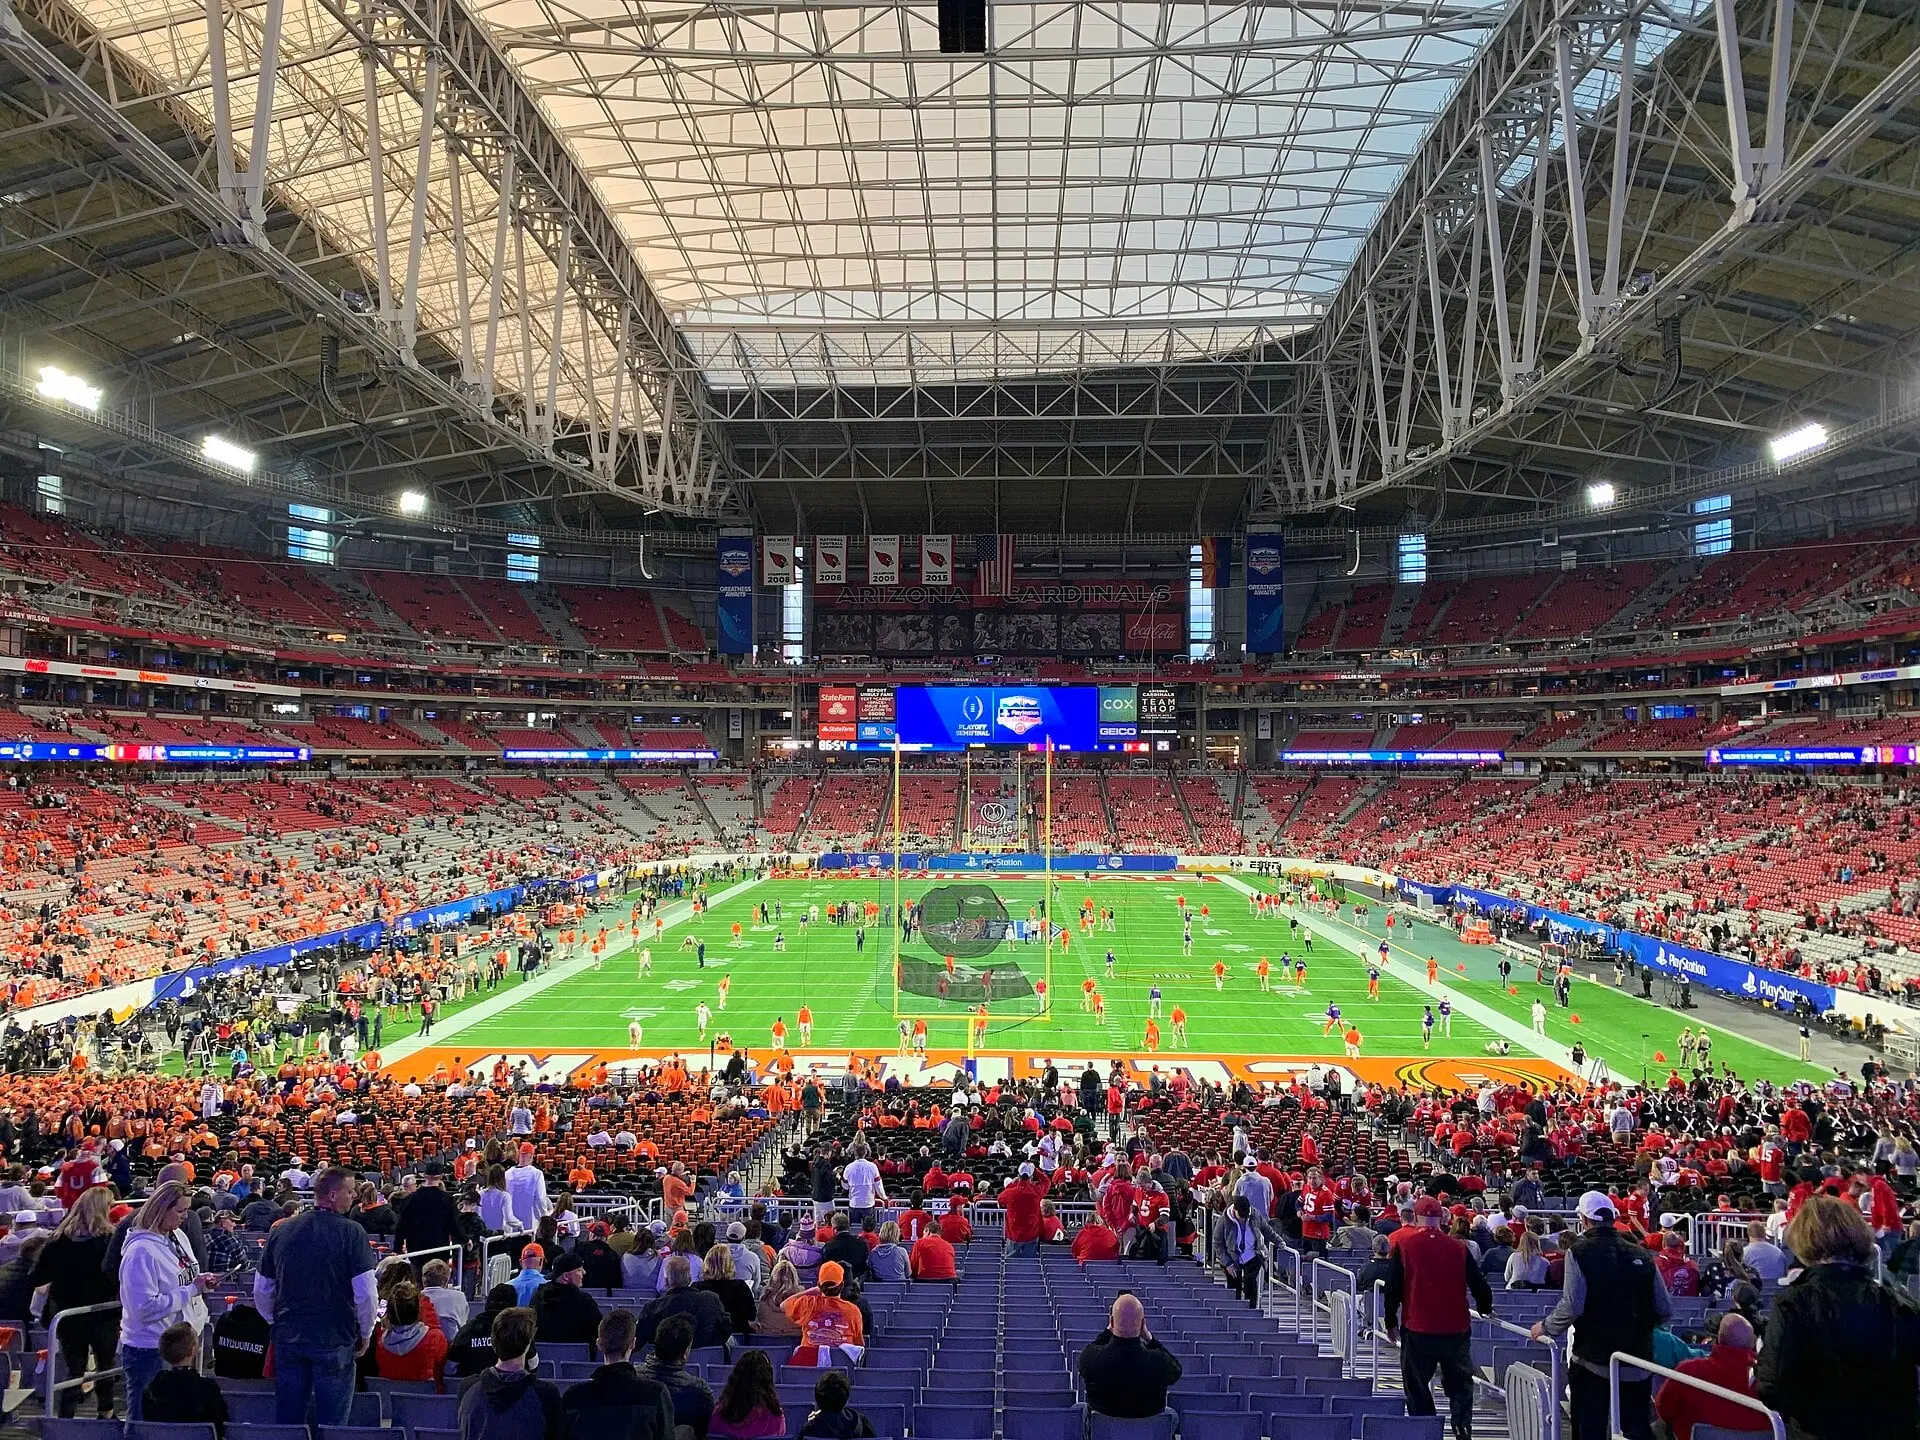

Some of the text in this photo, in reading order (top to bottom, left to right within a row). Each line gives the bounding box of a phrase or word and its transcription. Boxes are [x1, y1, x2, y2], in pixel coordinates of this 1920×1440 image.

[836, 585, 1172, 604] ARIZONA CARDINALS
[4, 611, 50, 623] LARRY WILSON
[1103, 699, 1134, 710] COX
[1141, 698, 1176, 706] TEAM
[1010, 709, 1040, 717] PlayStation
[1141, 705, 1176, 713] SHOP
[1099, 727, 1137, 736] GEICO
[630, 751, 673, 759] PLAYSTATION
[673, 751, 695, 759] FIESTA
[1457, 752, 1480, 760] FIESTA
[973, 825, 1013, 836] Allstate
[1668, 953, 1708, 977] PlayStation
[1631, 1102, 1637, 1112] 5
[1761, 1149, 1773, 1162] 15
[1665, 1160, 1675, 1170] 16
[1064, 1170, 1072, 1183] 5
[1303, 1192, 1317, 1212] 15
[910, 1218, 919, 1241] 1
